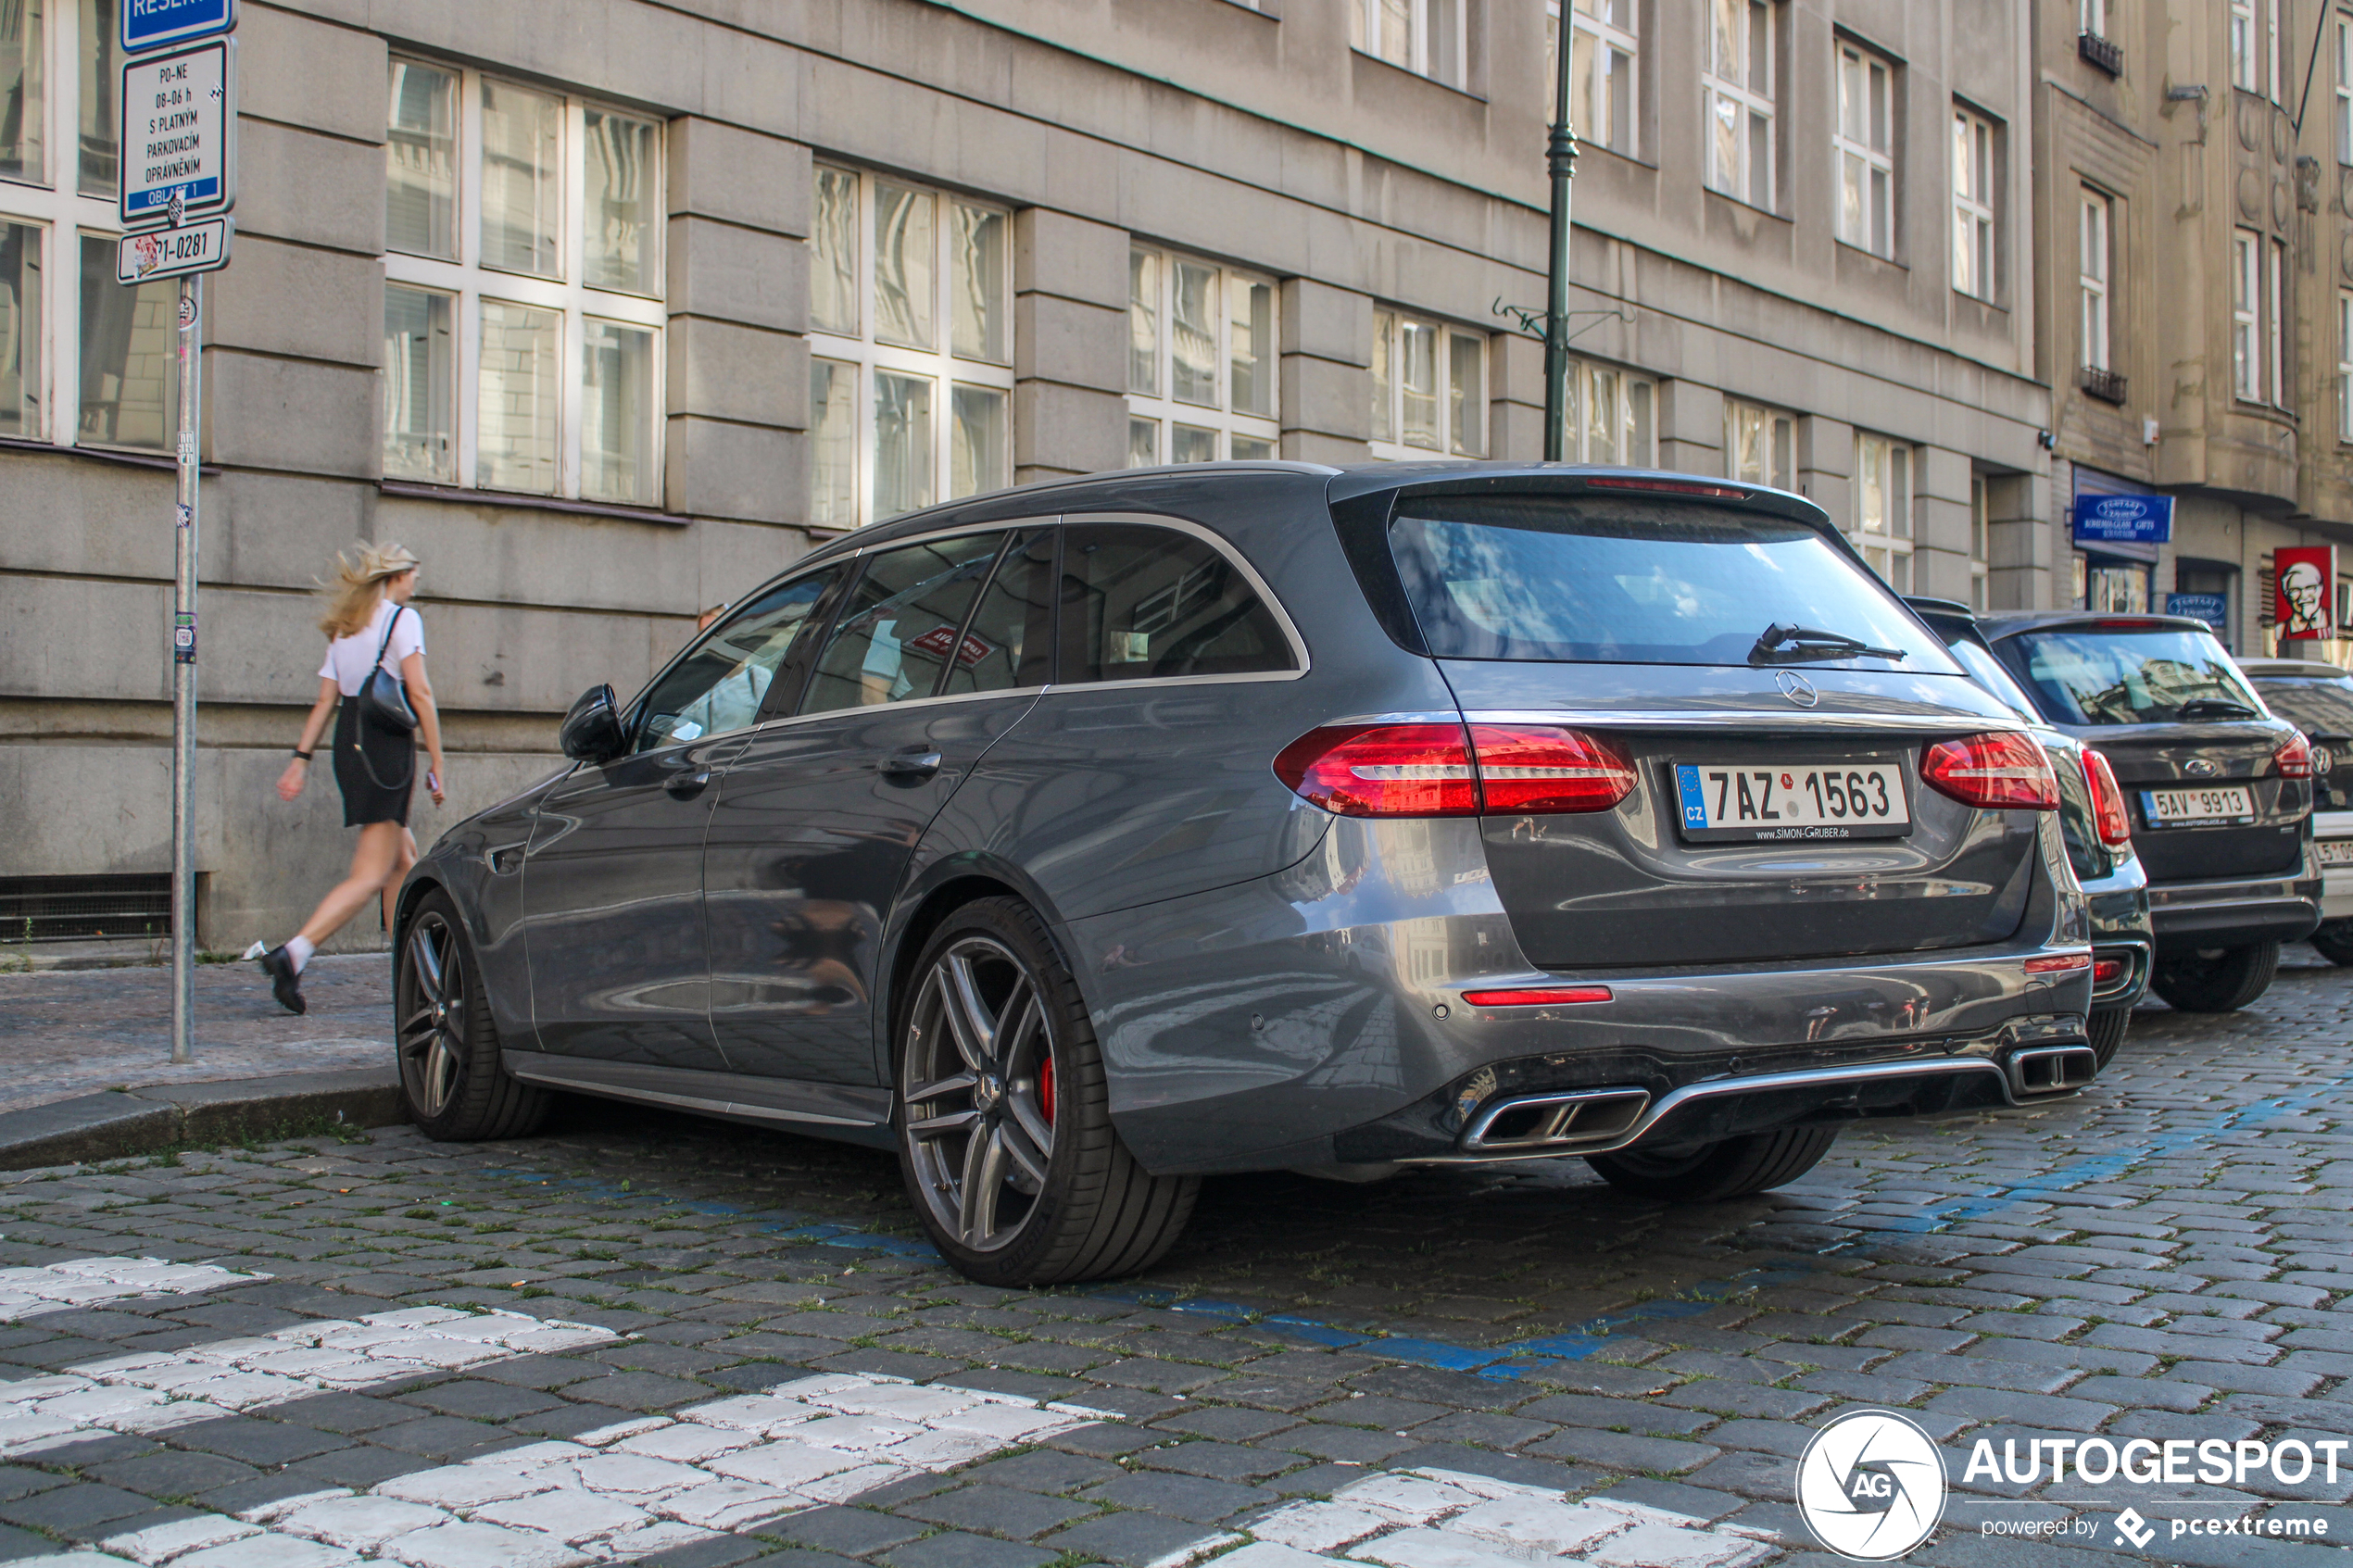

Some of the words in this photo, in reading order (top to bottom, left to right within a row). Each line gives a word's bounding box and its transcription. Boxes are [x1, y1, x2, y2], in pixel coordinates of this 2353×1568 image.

[159, 63, 188, 84] PO-NE
[156, 89, 182, 109] 08-06
[186, 87, 192, 103] h
[149, 119, 156, 134] S
[158, 107, 198, 132] PLATNÝM
[147, 131, 200, 159] PARKOVACÍM
[145, 155, 201, 183] OPRÁVNĚNÍM
[193, 182, 197, 196] 1
[1686, 806, 1704, 822] CZ
[1709, 772, 1780, 821] 7AZ
[1805, 771, 1890, 819] 1563
[2156, 793, 2188, 816] 5AV
[2200, 791, 2244, 814] 9913
